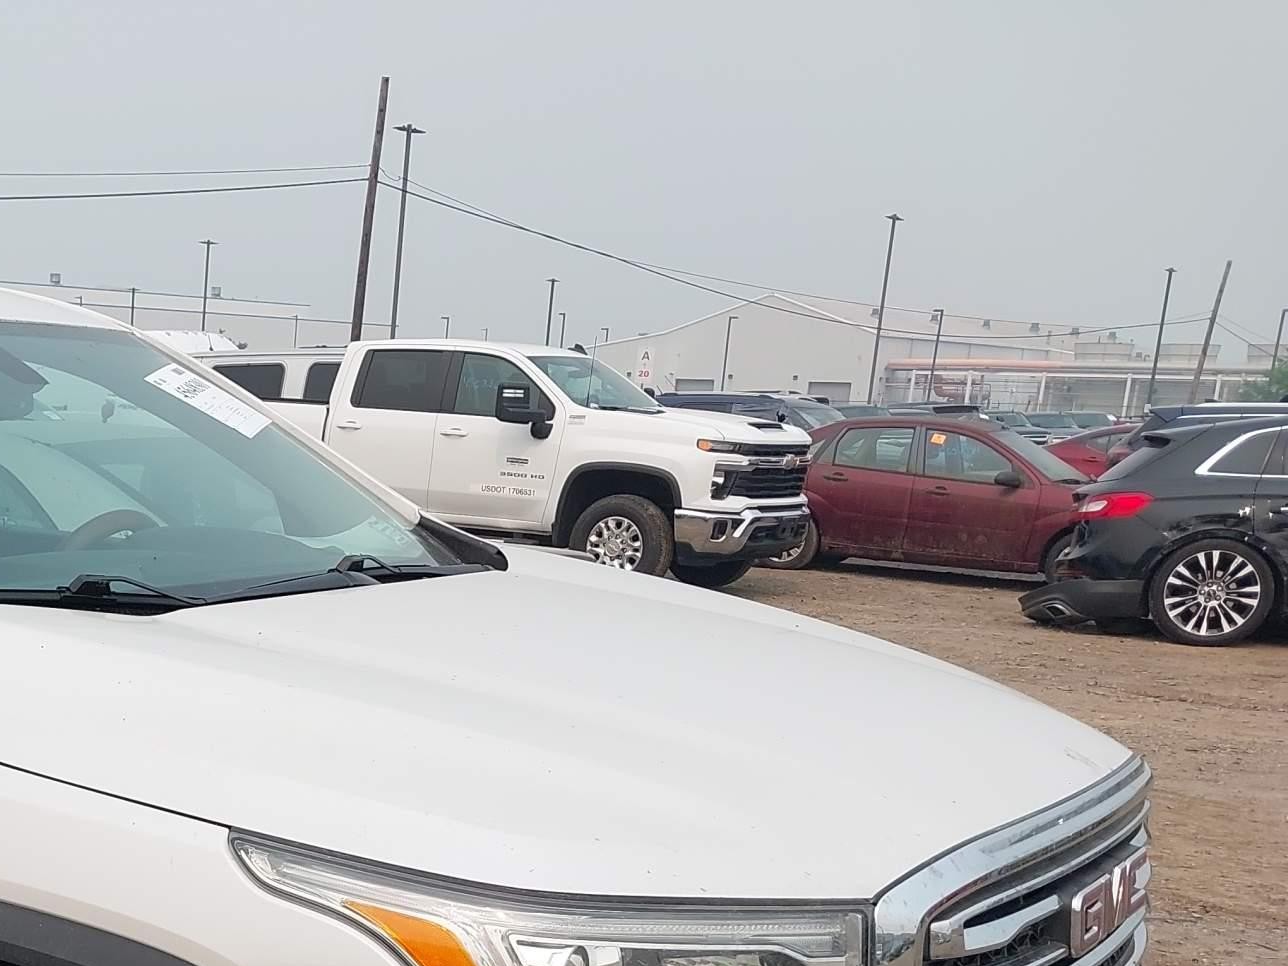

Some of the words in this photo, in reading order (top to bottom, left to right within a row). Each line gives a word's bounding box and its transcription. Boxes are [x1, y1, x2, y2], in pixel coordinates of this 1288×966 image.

[641, 351, 650, 361] A
[637, 370, 650, 378] 20
[499, 471, 528, 479] 3500
[480, 484, 506, 494] USDOT
[1070, 845, 1149, 959] GMC
